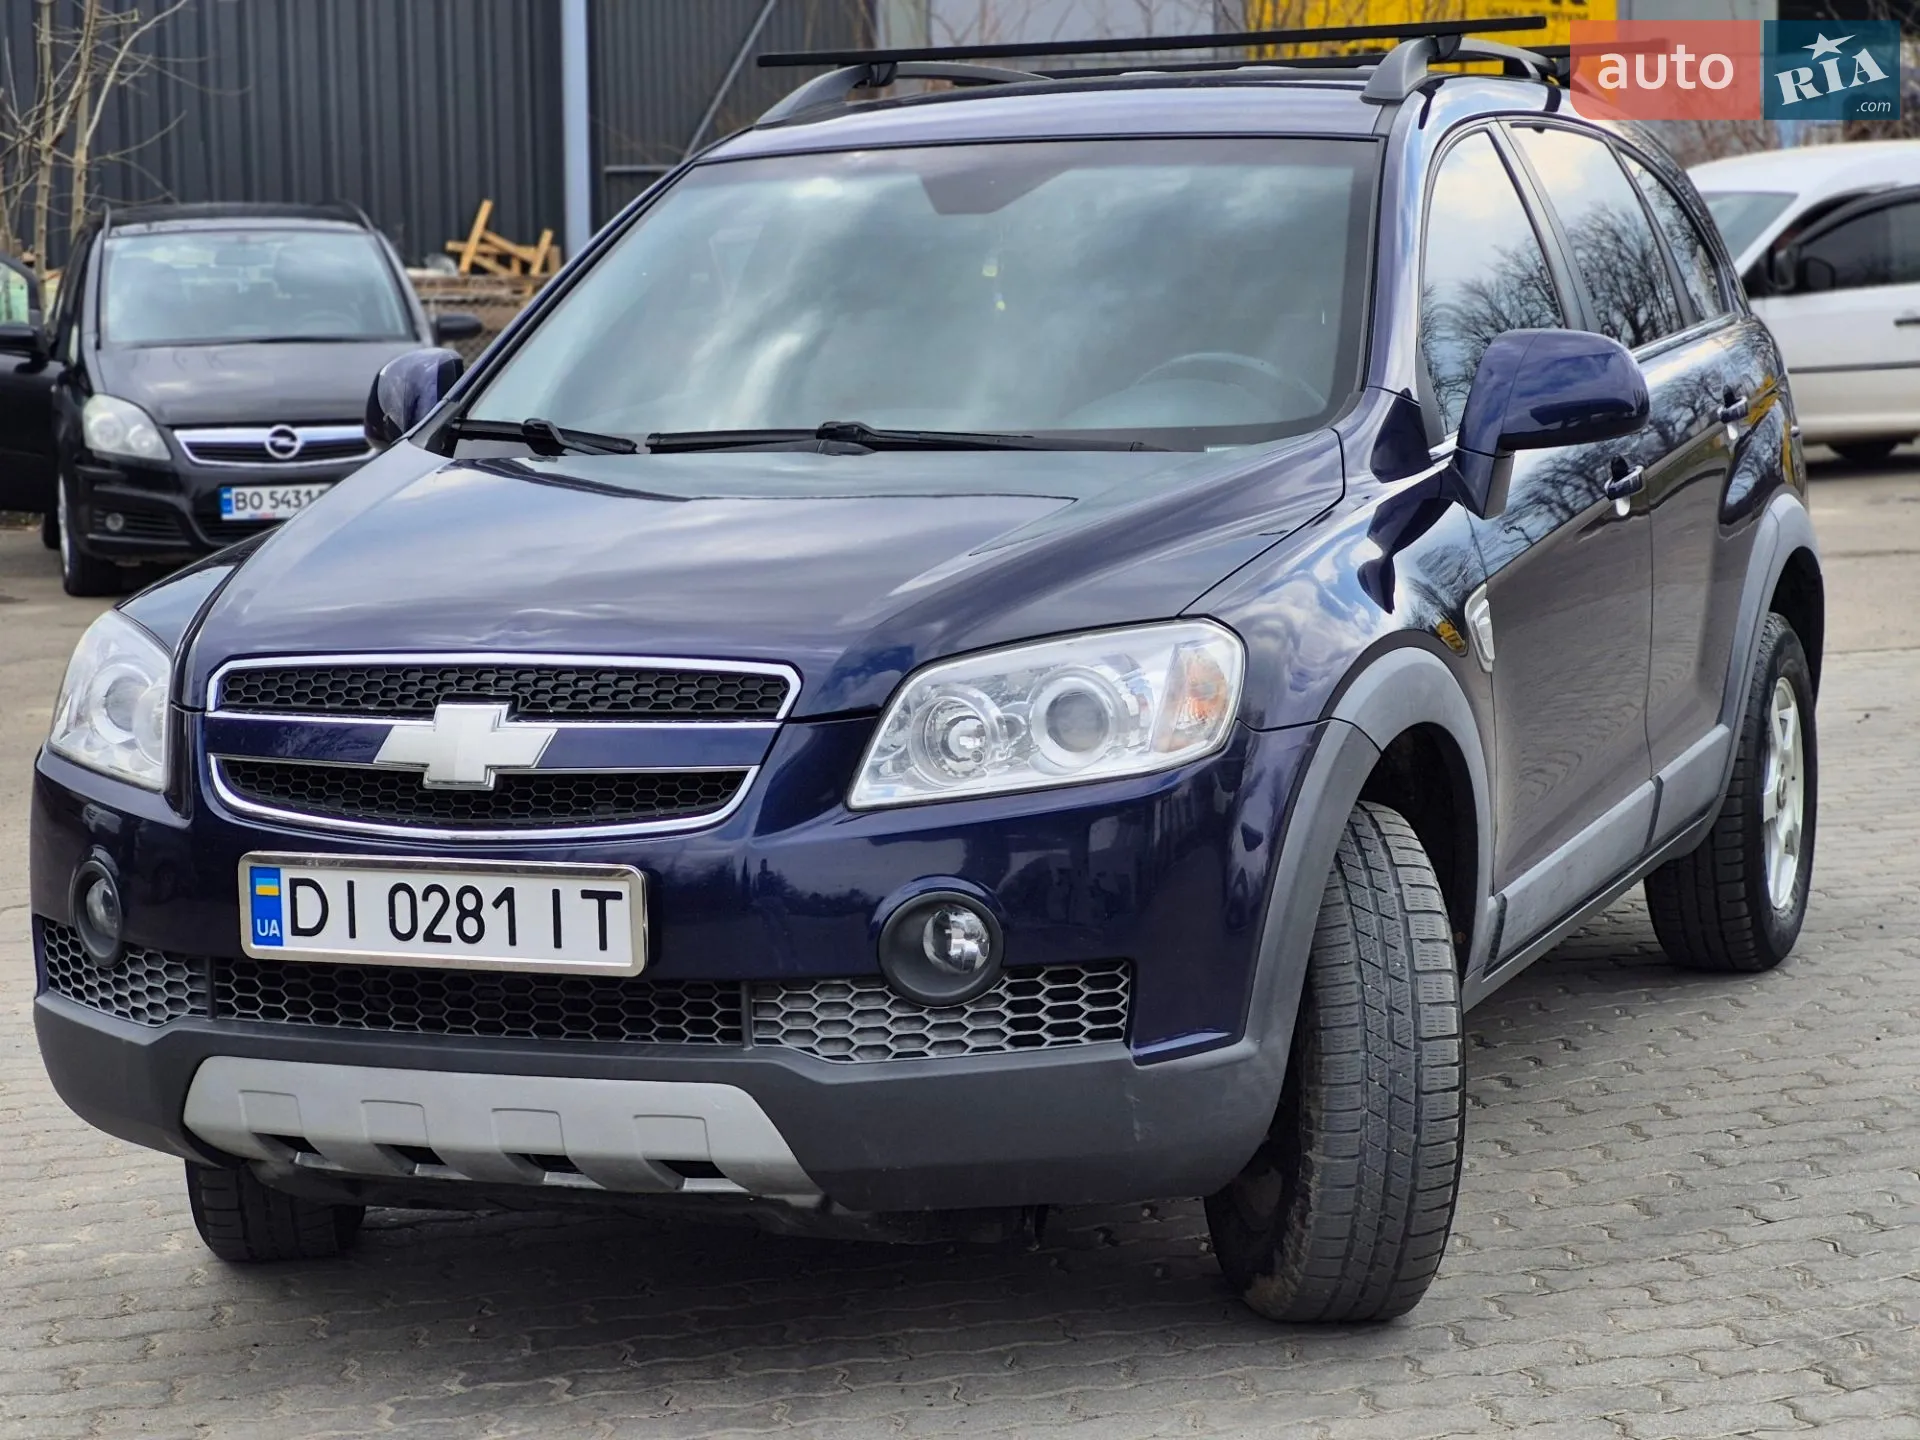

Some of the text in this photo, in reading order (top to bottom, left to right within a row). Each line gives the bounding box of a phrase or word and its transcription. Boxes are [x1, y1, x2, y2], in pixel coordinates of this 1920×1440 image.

[234, 491, 264, 511] BO
[288, 877, 623, 951] DI 0281 IT
[256, 918, 281, 938] UA
